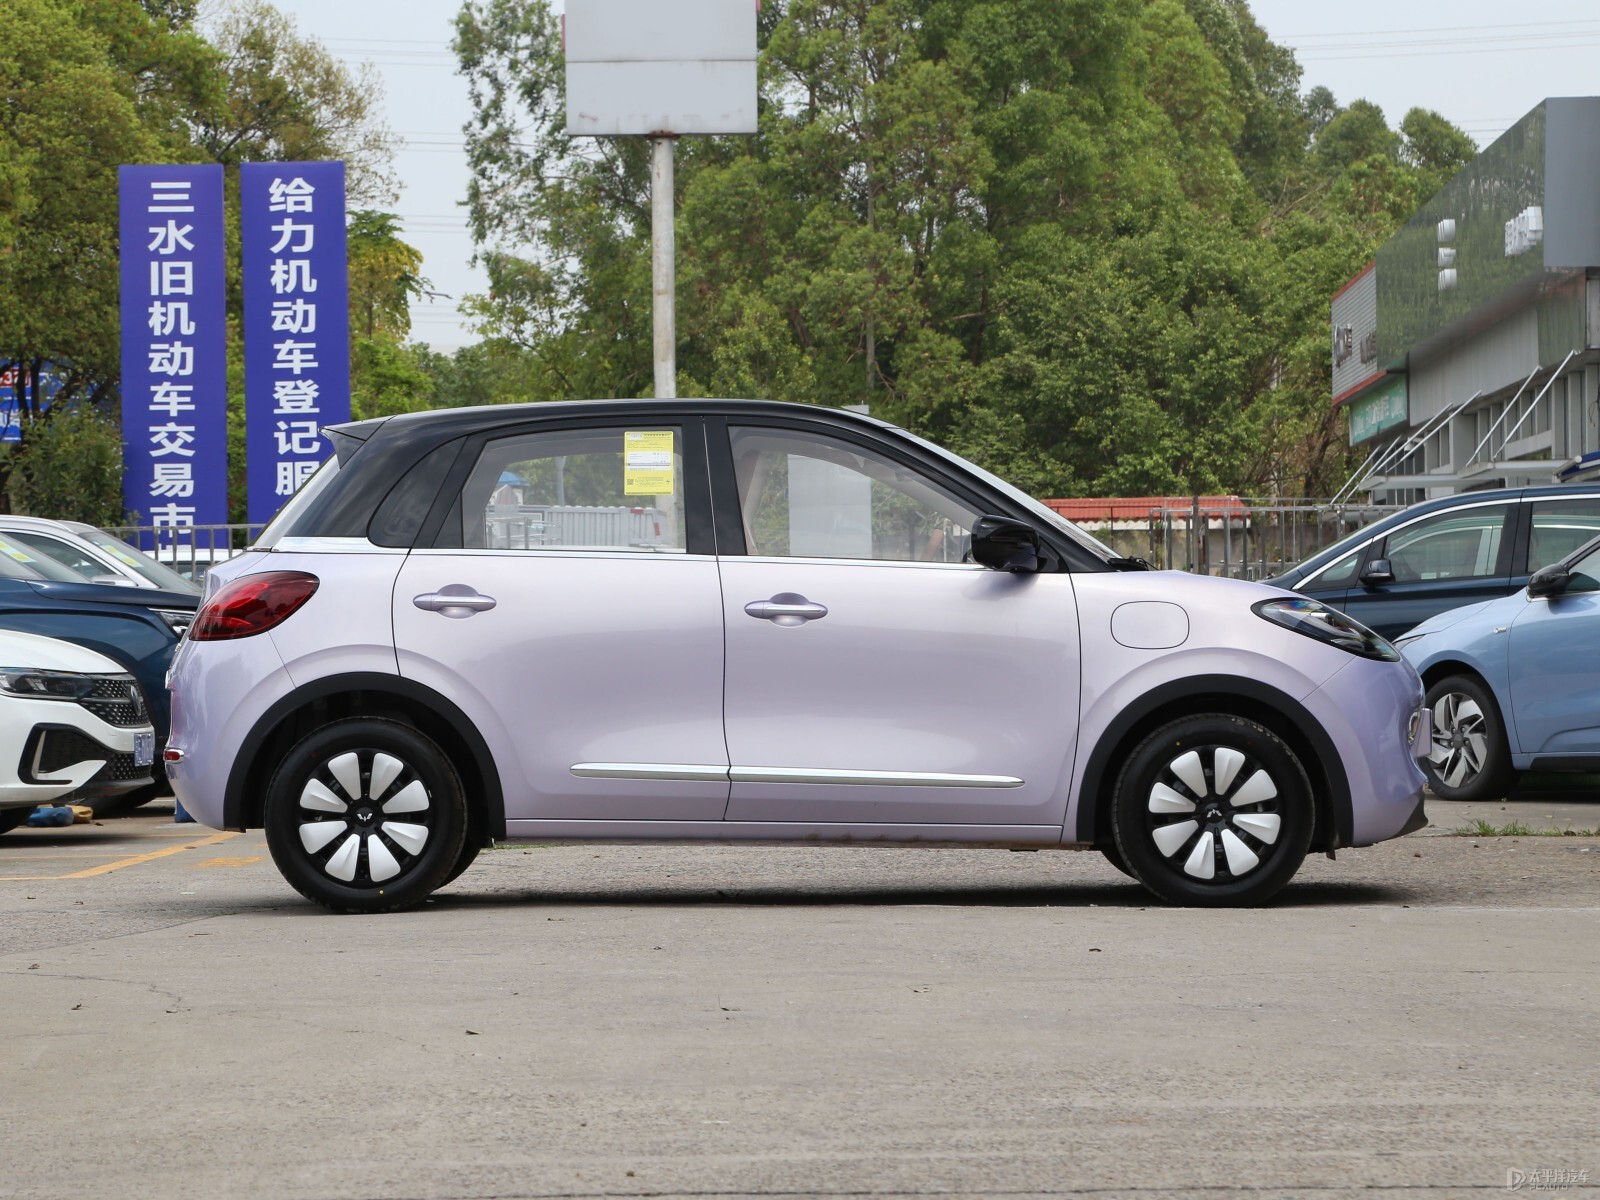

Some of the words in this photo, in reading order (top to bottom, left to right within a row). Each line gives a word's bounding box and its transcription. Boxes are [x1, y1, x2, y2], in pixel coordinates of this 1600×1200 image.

[148, 181, 195, 551] 三水旧机动车交易市
[269, 177, 321, 512] 给力机动车登记服
